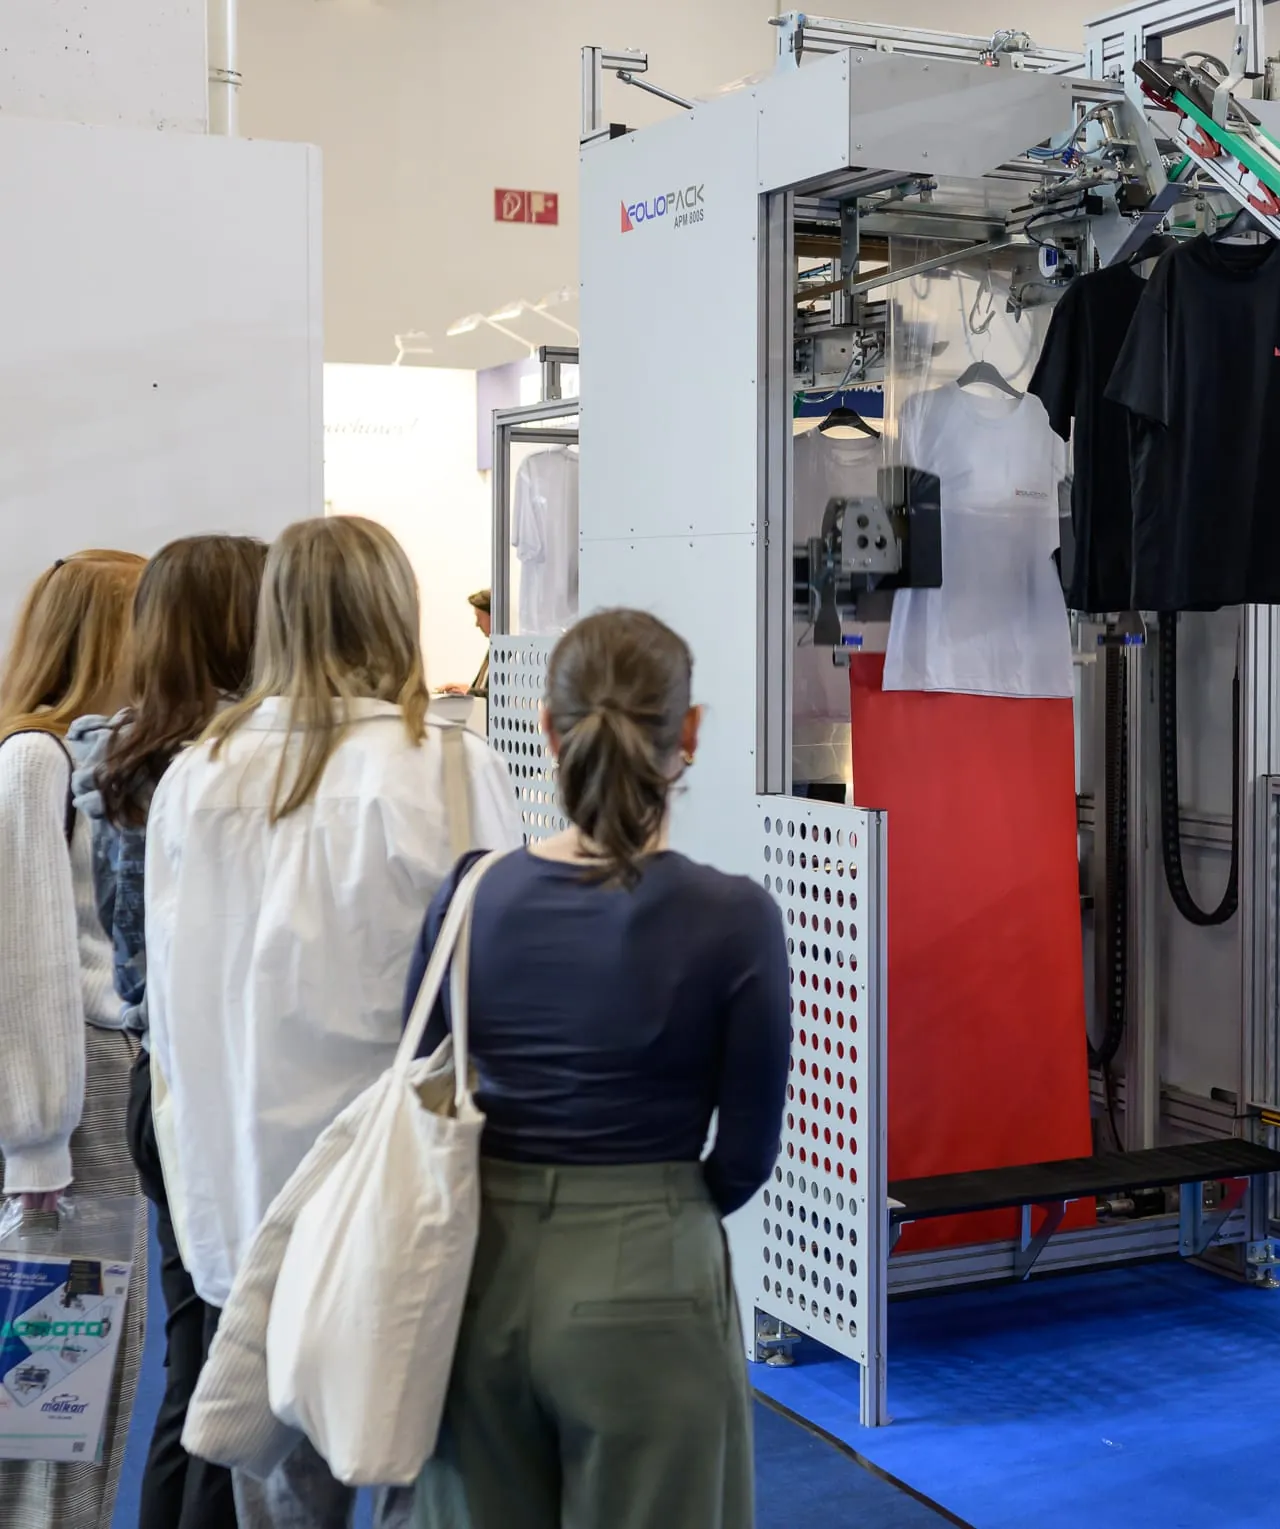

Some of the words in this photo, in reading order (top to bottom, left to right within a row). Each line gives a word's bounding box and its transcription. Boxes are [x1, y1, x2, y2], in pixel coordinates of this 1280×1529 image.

[626, 183, 705, 224] FOLIOPACK
[674, 213, 688, 229] APM
[41, 1400, 89, 1414] malkan
